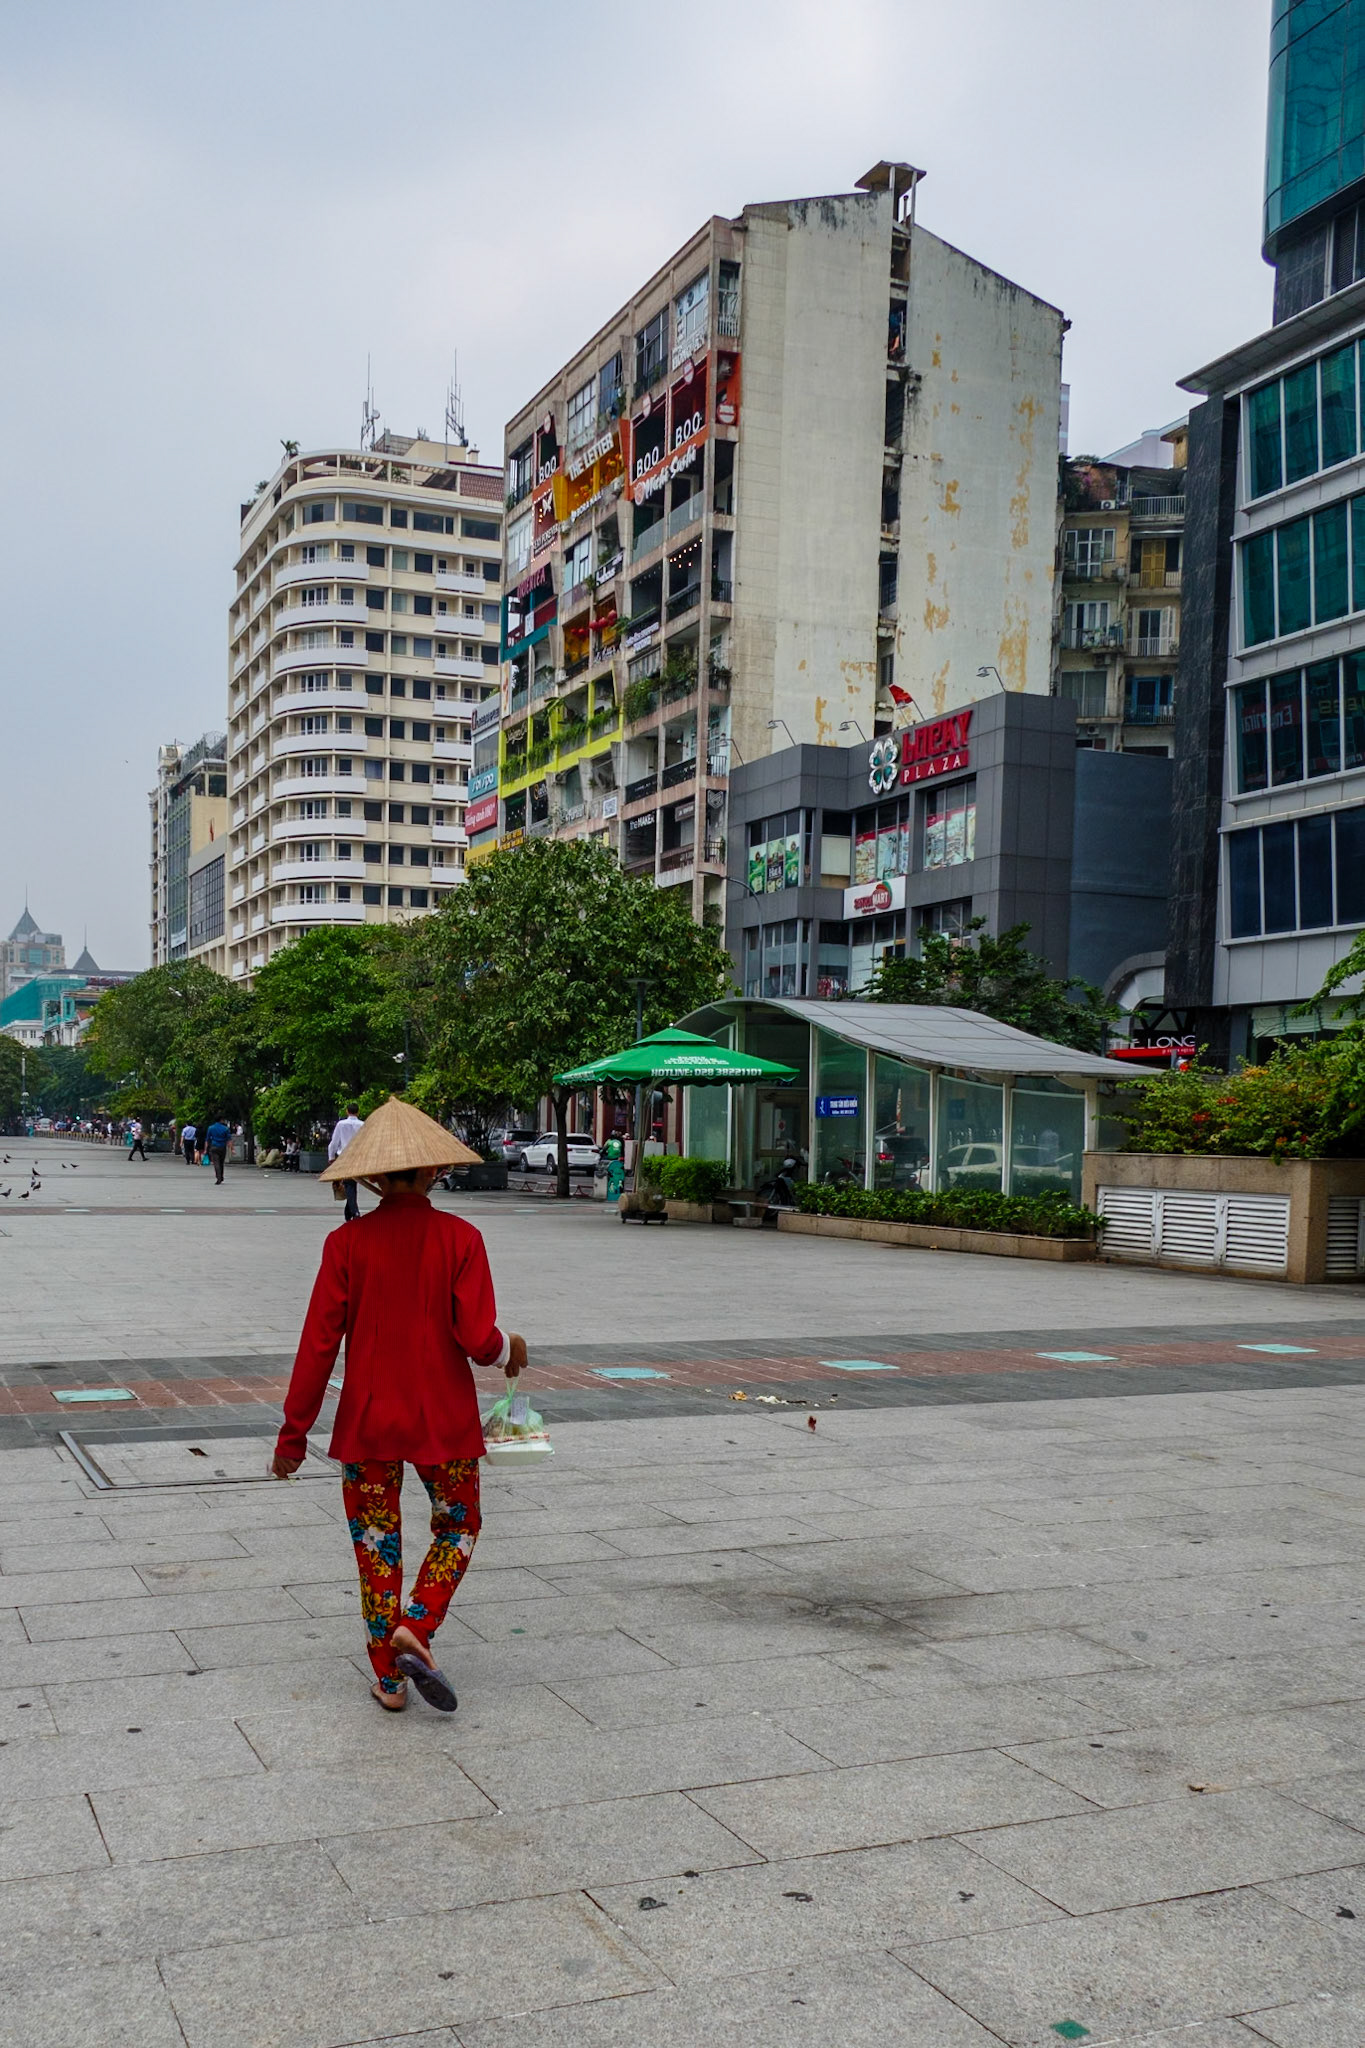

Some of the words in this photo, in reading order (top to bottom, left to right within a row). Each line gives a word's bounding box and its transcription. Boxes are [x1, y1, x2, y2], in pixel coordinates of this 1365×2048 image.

[675, 411, 700, 448] BOO
[583, 432, 614, 468] LETTER
[636, 446, 659, 478] BOO
[539, 455, 557, 484] BOO
[904, 754, 961, 783] PLAZA
[1147, 1035, 1196, 1049] LONG
[651, 1068, 693, 1077] HOTLINE:
[694, 1068, 714, 1077] 028
